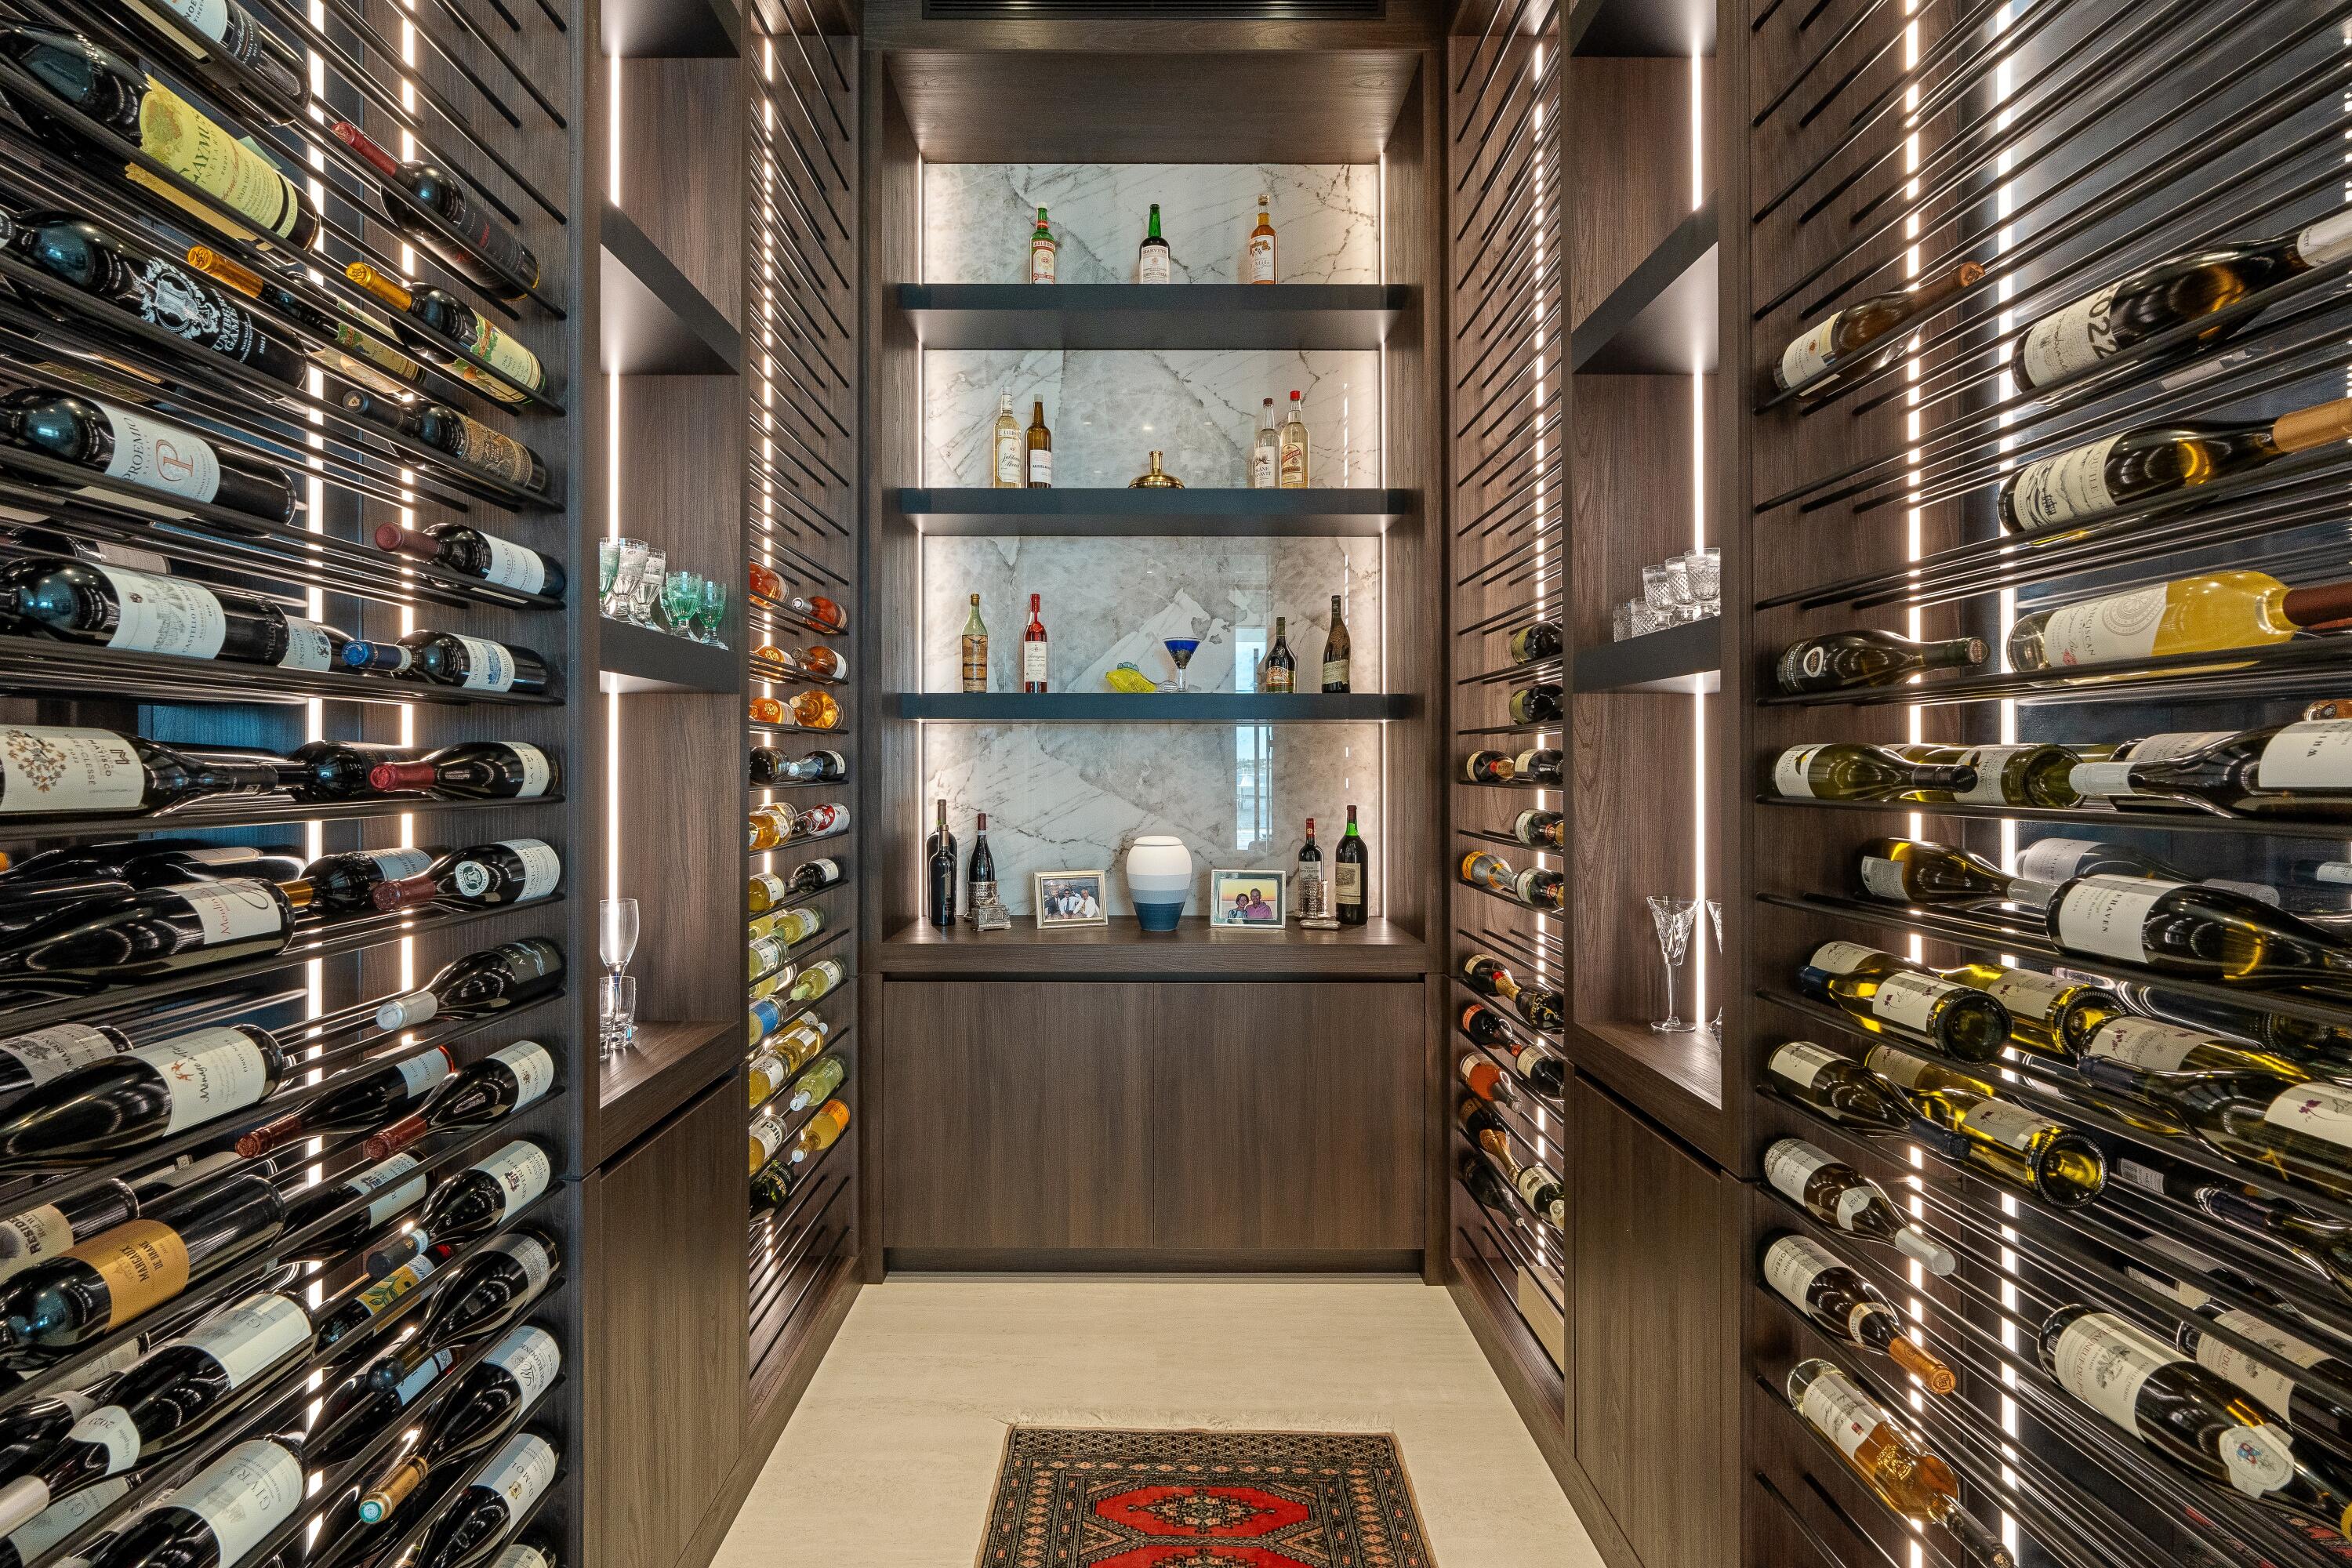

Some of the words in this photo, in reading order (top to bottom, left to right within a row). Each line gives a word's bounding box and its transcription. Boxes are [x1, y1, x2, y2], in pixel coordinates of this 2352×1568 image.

[224, 307, 240, 351] GAME
[121, 417, 143, 482] PROEMIO
[182, 612, 198, 654] CASTELLO
[87, 739, 112, 778] MATISCO
[1956, 773, 1975, 784] MOHUA
[119, 1244, 151, 1284] MARGAUX
[139, 1240, 162, 1261] BRANE
[154, 1259, 164, 1270] DE
[520, 1343, 544, 1389] BOURGOGNE
